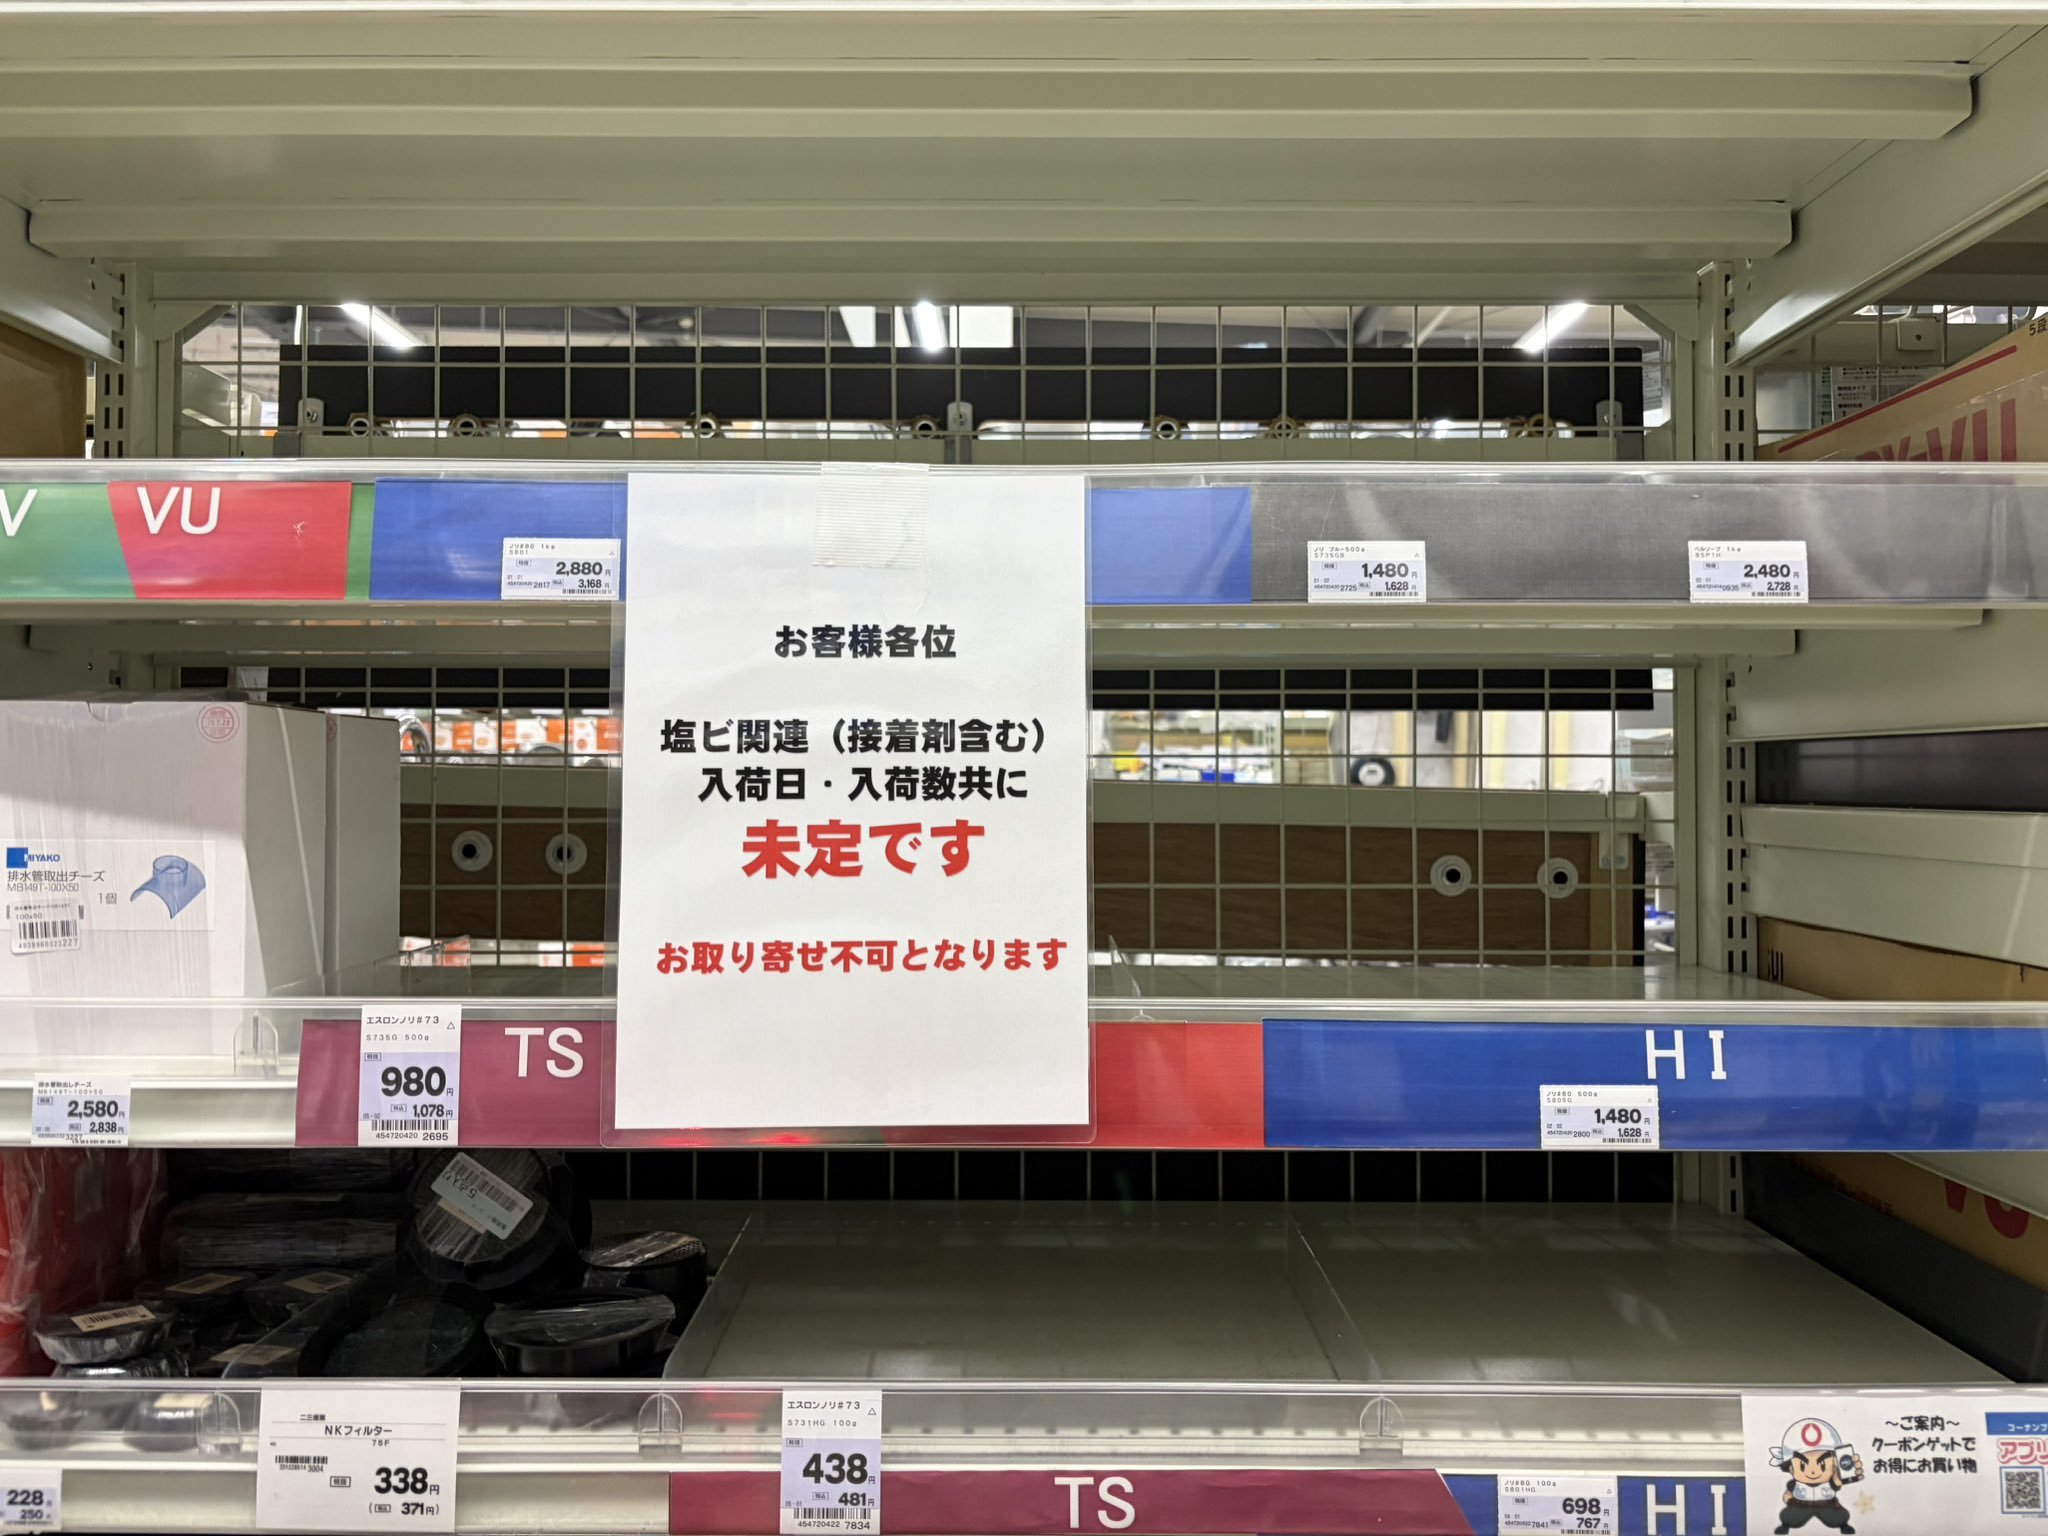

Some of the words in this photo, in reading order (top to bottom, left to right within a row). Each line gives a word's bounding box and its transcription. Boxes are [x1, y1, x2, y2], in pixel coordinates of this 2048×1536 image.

[136, 486, 221, 535] VU
[774, 624, 957, 659] お客様各位
[698, 766, 1029, 802] 入荷日・入荷数共に
[741, 818, 985, 879] 未定です
[24, 854, 61, 862] MIYAKO
[7, 870, 106, 882] 排水管取出チーズ
[99, 893, 117, 904] 1個
[656, 939, 1068, 974] お取り寄せ不可となります
[505, 1027, 584, 1078] TS
[422, 1132, 449, 1141] 2695
[324, 1425, 392, 1436] NKフィルター
[1872, 1436, 1976, 1452] クーポンゲットで
[1873, 1457, 1978, 1473] お得にお買い物
[6, 1489, 44, 1506] 228
[1054, 1476, 1136, 1529] TS
[844, 1521, 870, 1530] 7834
